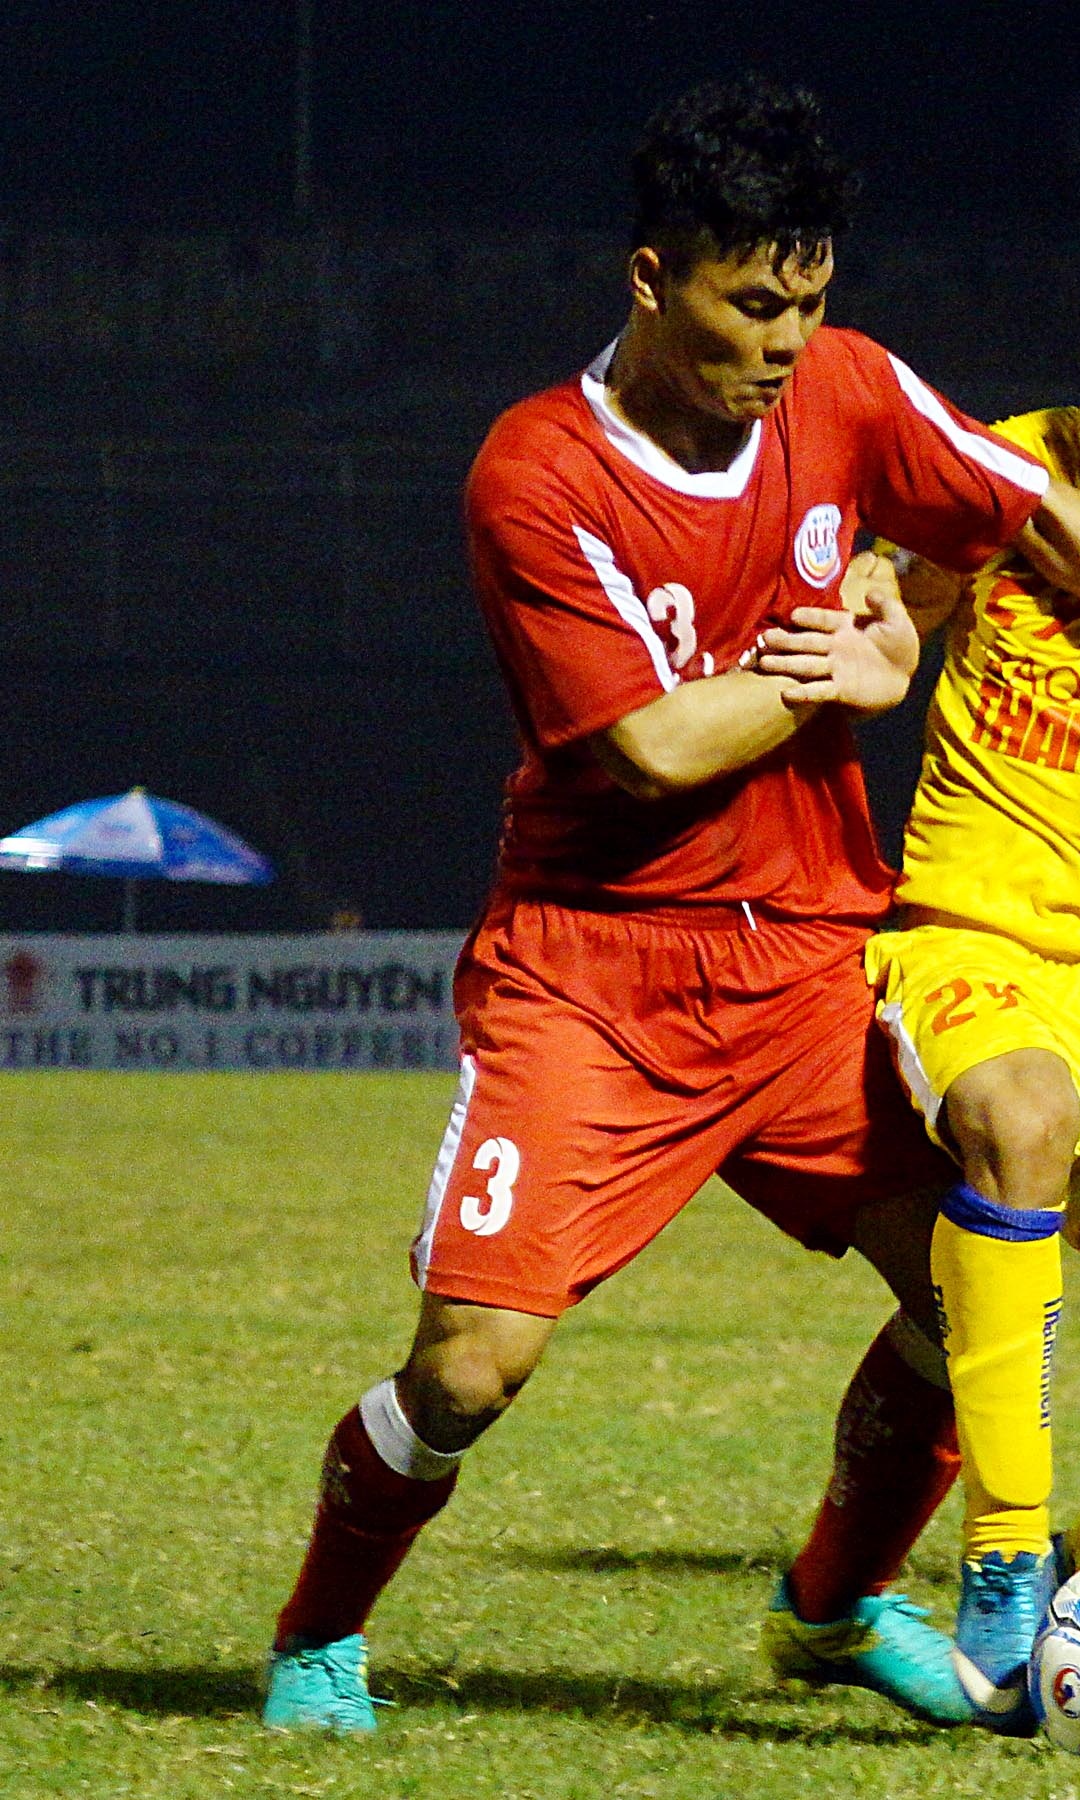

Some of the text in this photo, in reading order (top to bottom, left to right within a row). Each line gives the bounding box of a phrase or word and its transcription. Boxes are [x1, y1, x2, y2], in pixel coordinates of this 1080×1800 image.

[647, 582, 697, 669] 3
[75, 965, 236, 1012] TRUNG
[2, 1028, 91, 1066] THE
[460, 1136, 520, 1236] 3
